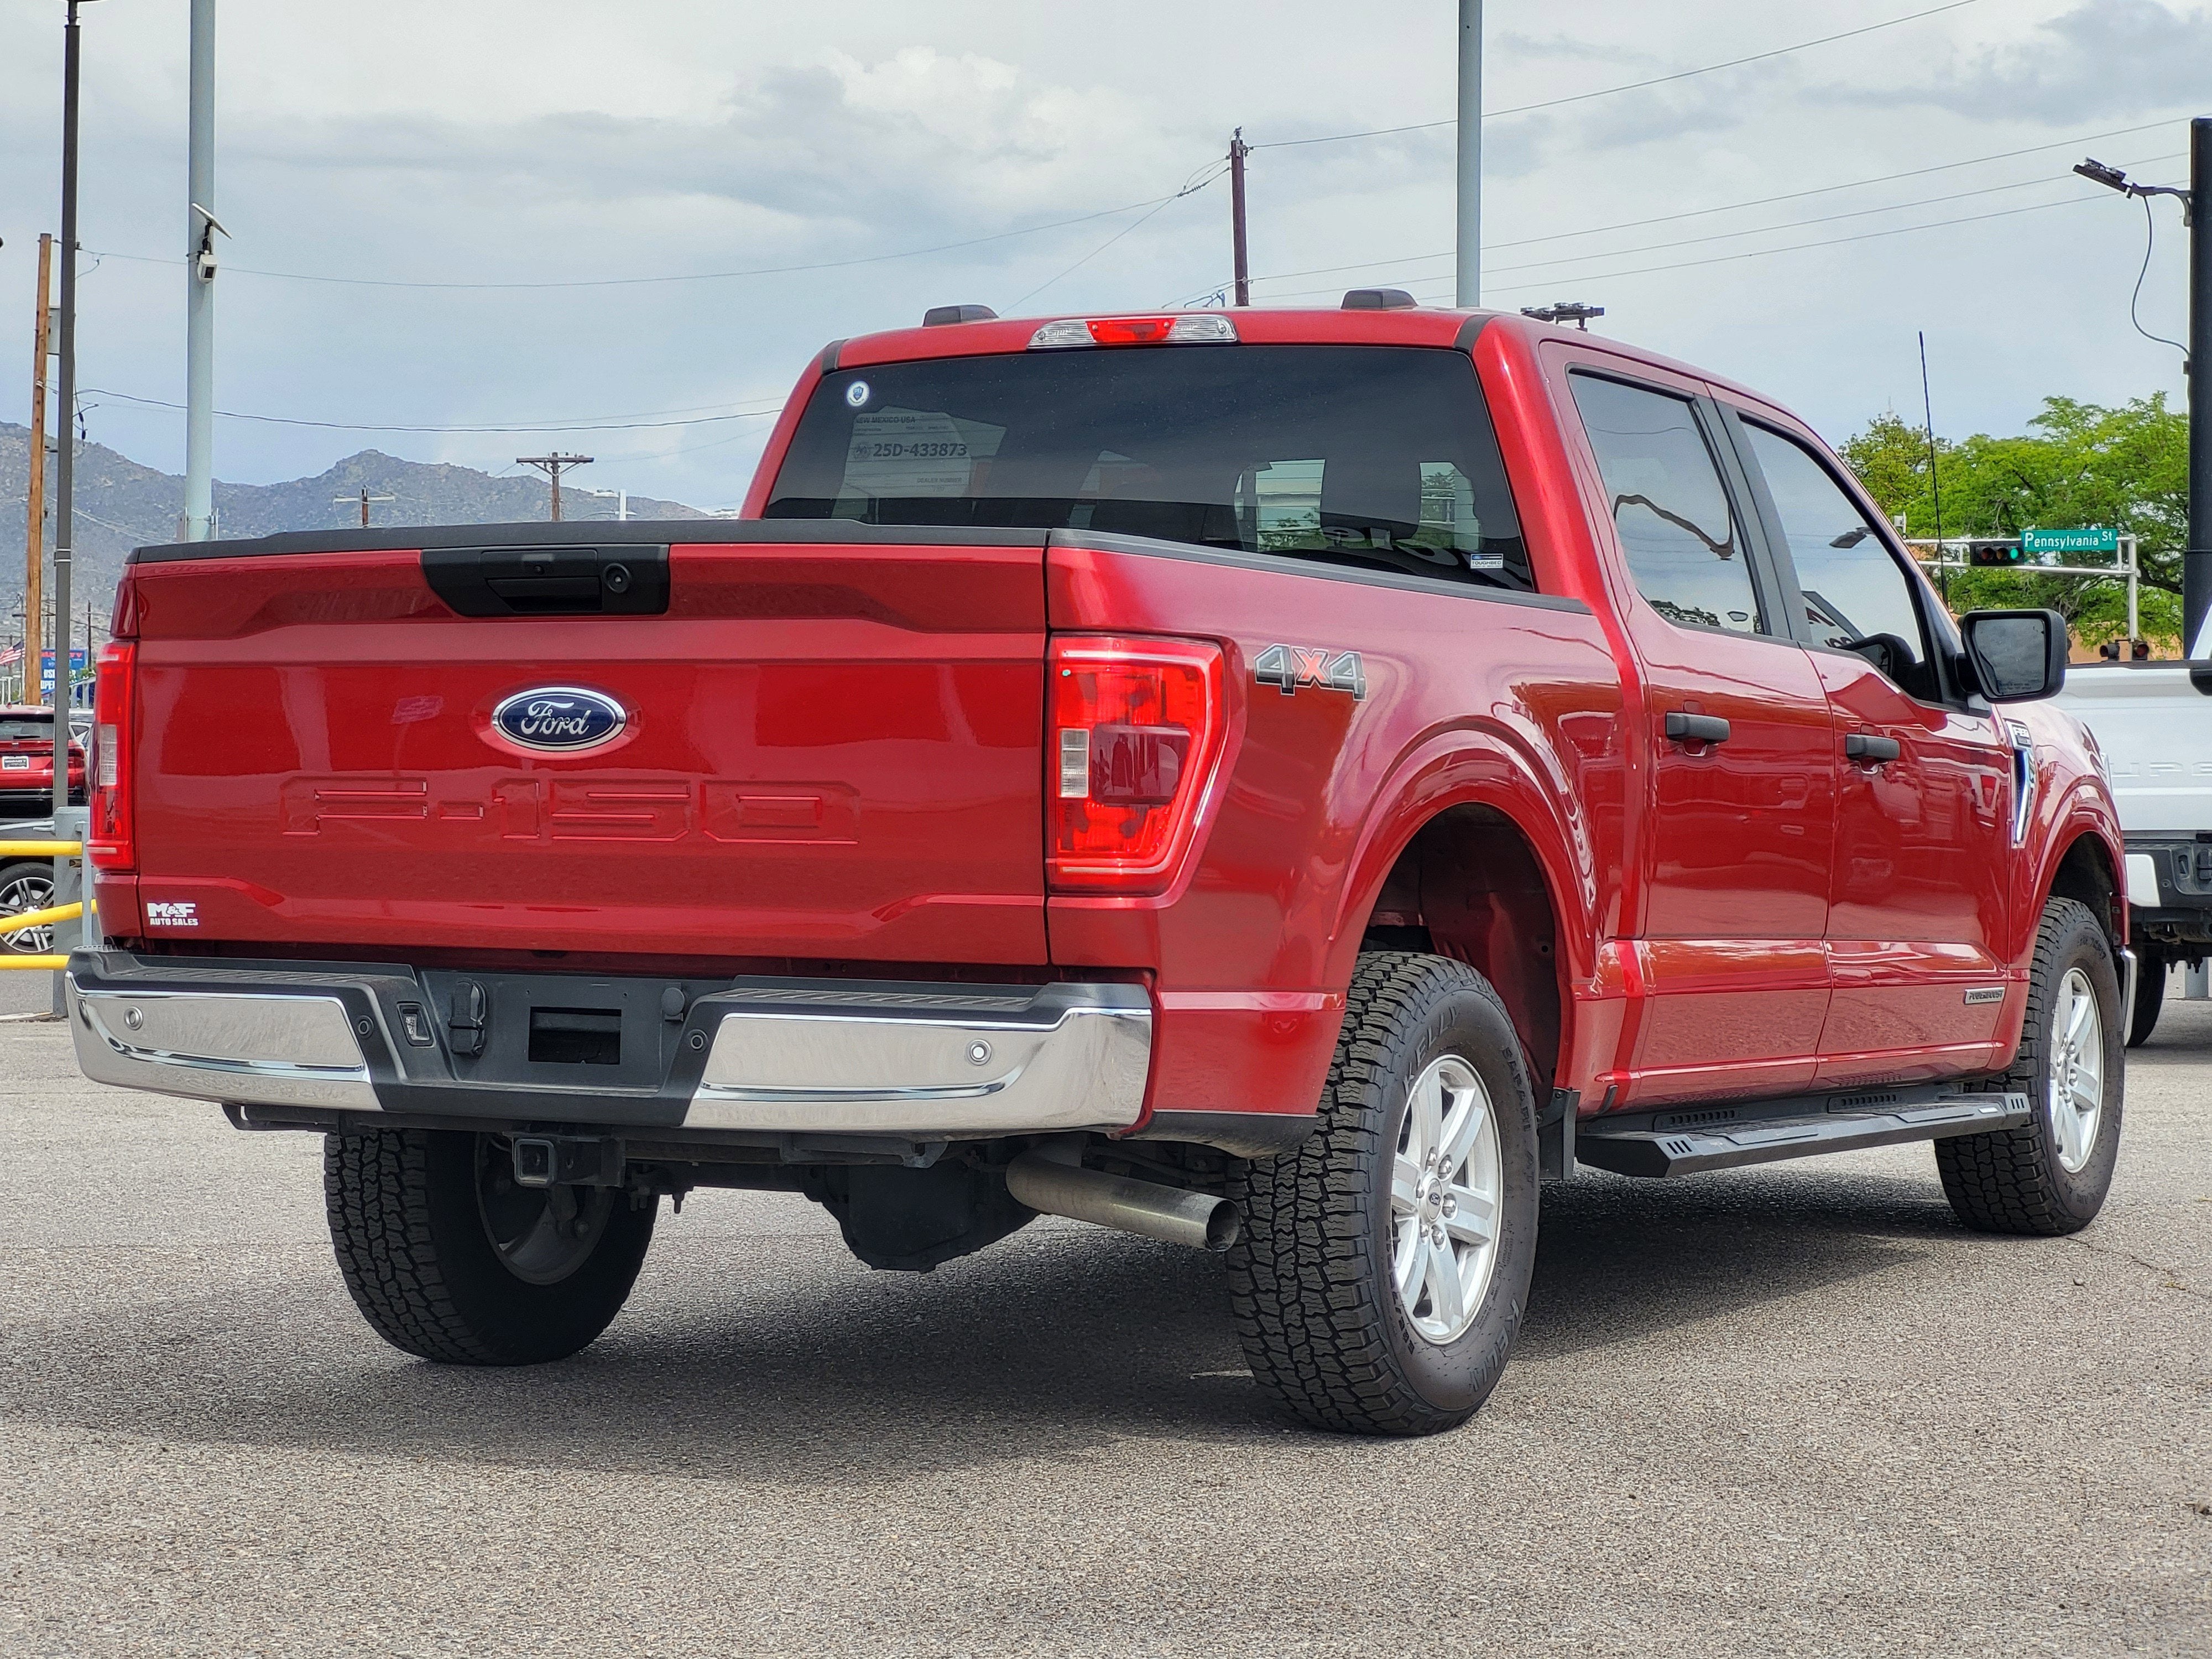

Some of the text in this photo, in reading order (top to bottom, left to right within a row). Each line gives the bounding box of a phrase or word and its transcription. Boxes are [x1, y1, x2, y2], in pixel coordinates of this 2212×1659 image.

[873, 443, 967, 457] 25D-433873
[2025, 531, 2112, 549] Pennsylvania St
[520, 700, 591, 735] Ford
[279, 776, 860, 844] F-150
[147, 902, 196, 917] M&F
[1402, 1006, 1460, 1099] KELLY
[1469, 1298, 1520, 1391] KELLY
